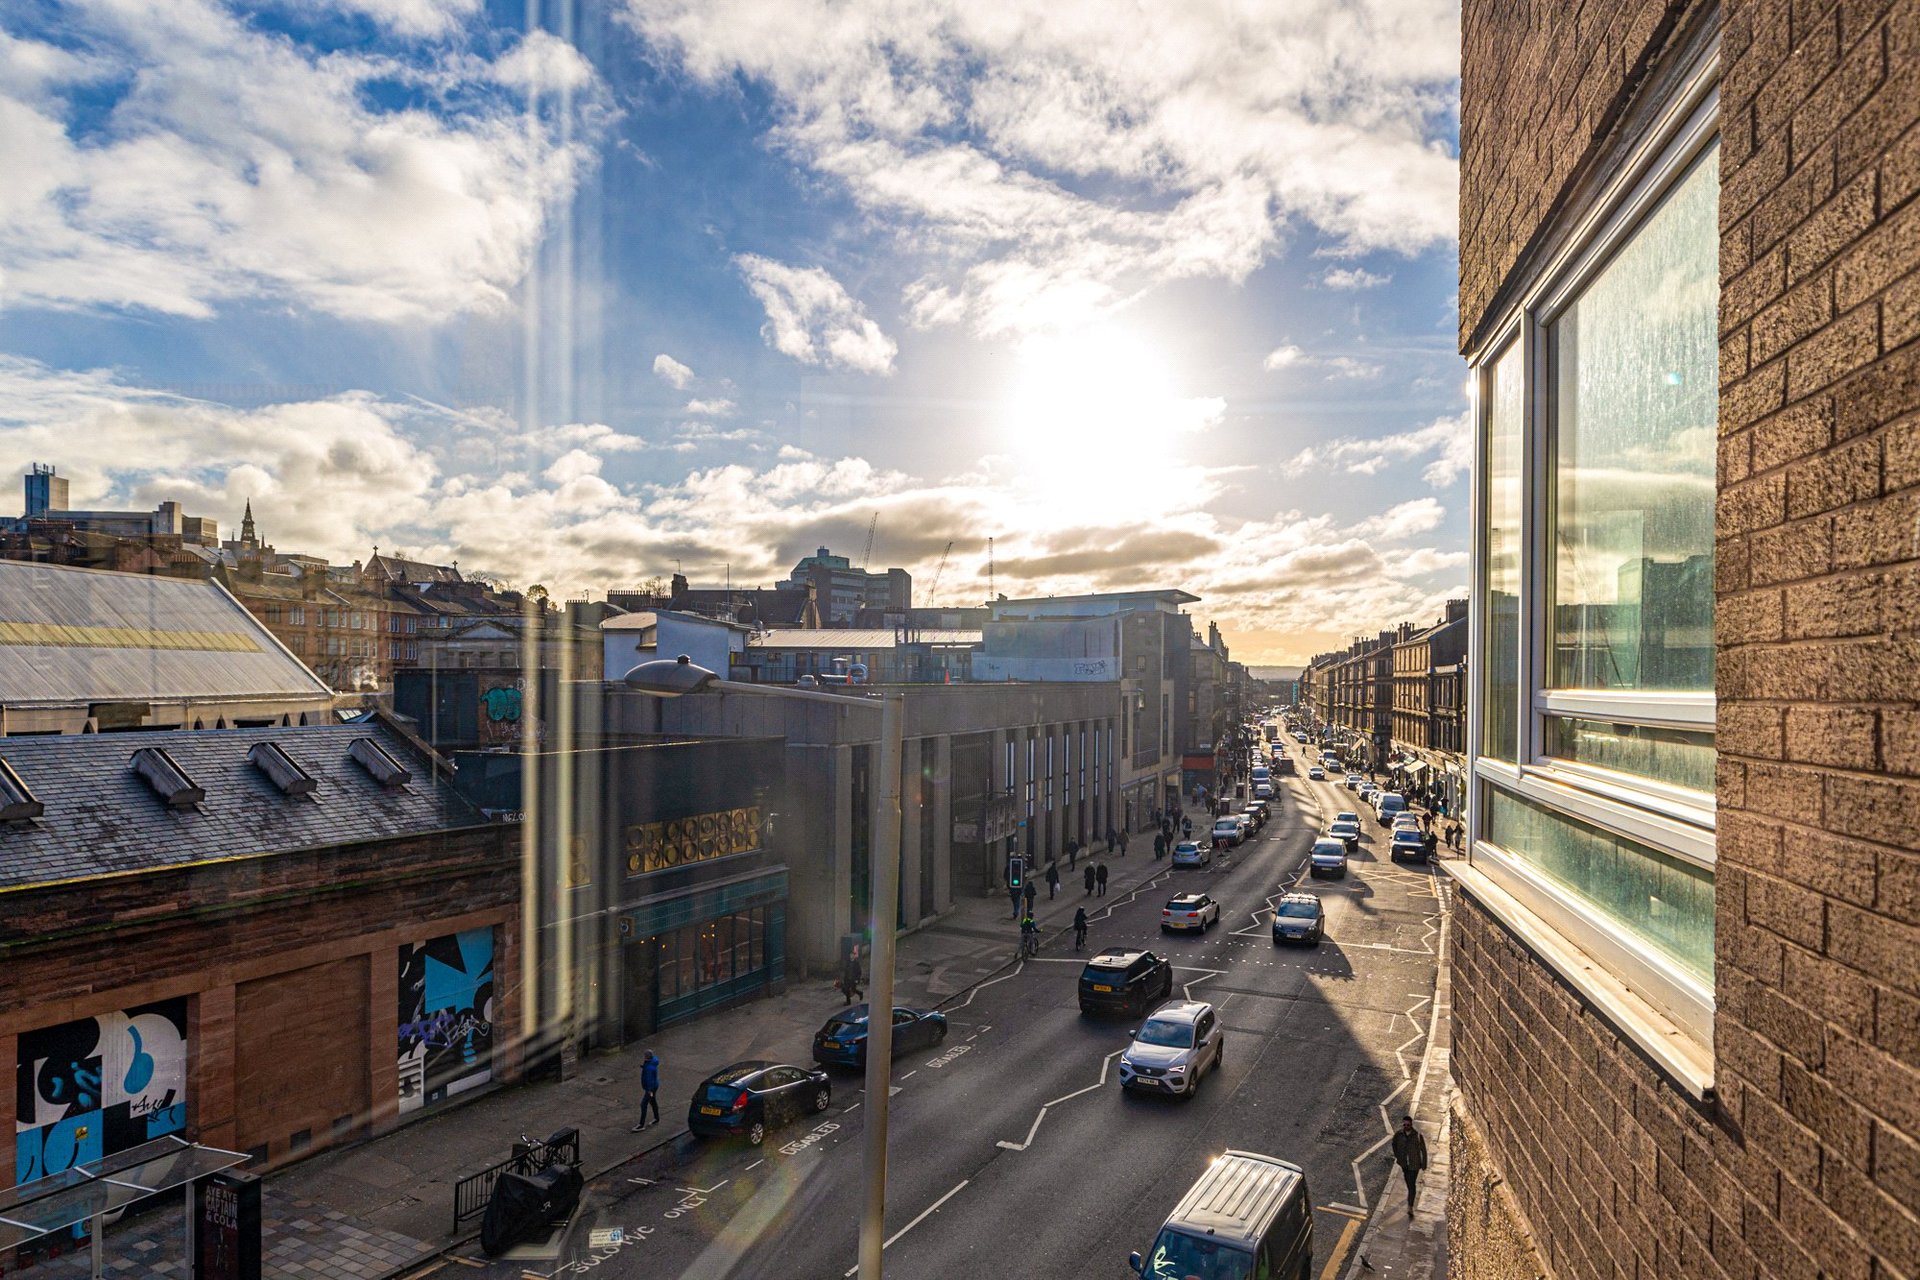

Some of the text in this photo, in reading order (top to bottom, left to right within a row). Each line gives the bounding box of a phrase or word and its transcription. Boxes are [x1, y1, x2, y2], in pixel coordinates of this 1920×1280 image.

[780, 1123, 841, 1155] DISABLED
[206, 1185, 238, 1203] AYE AYE
[205, 1196, 238, 1219] CAPTAIN
[663, 1195, 708, 1219] ONLY
[206, 1210, 238, 1230] & COLA
